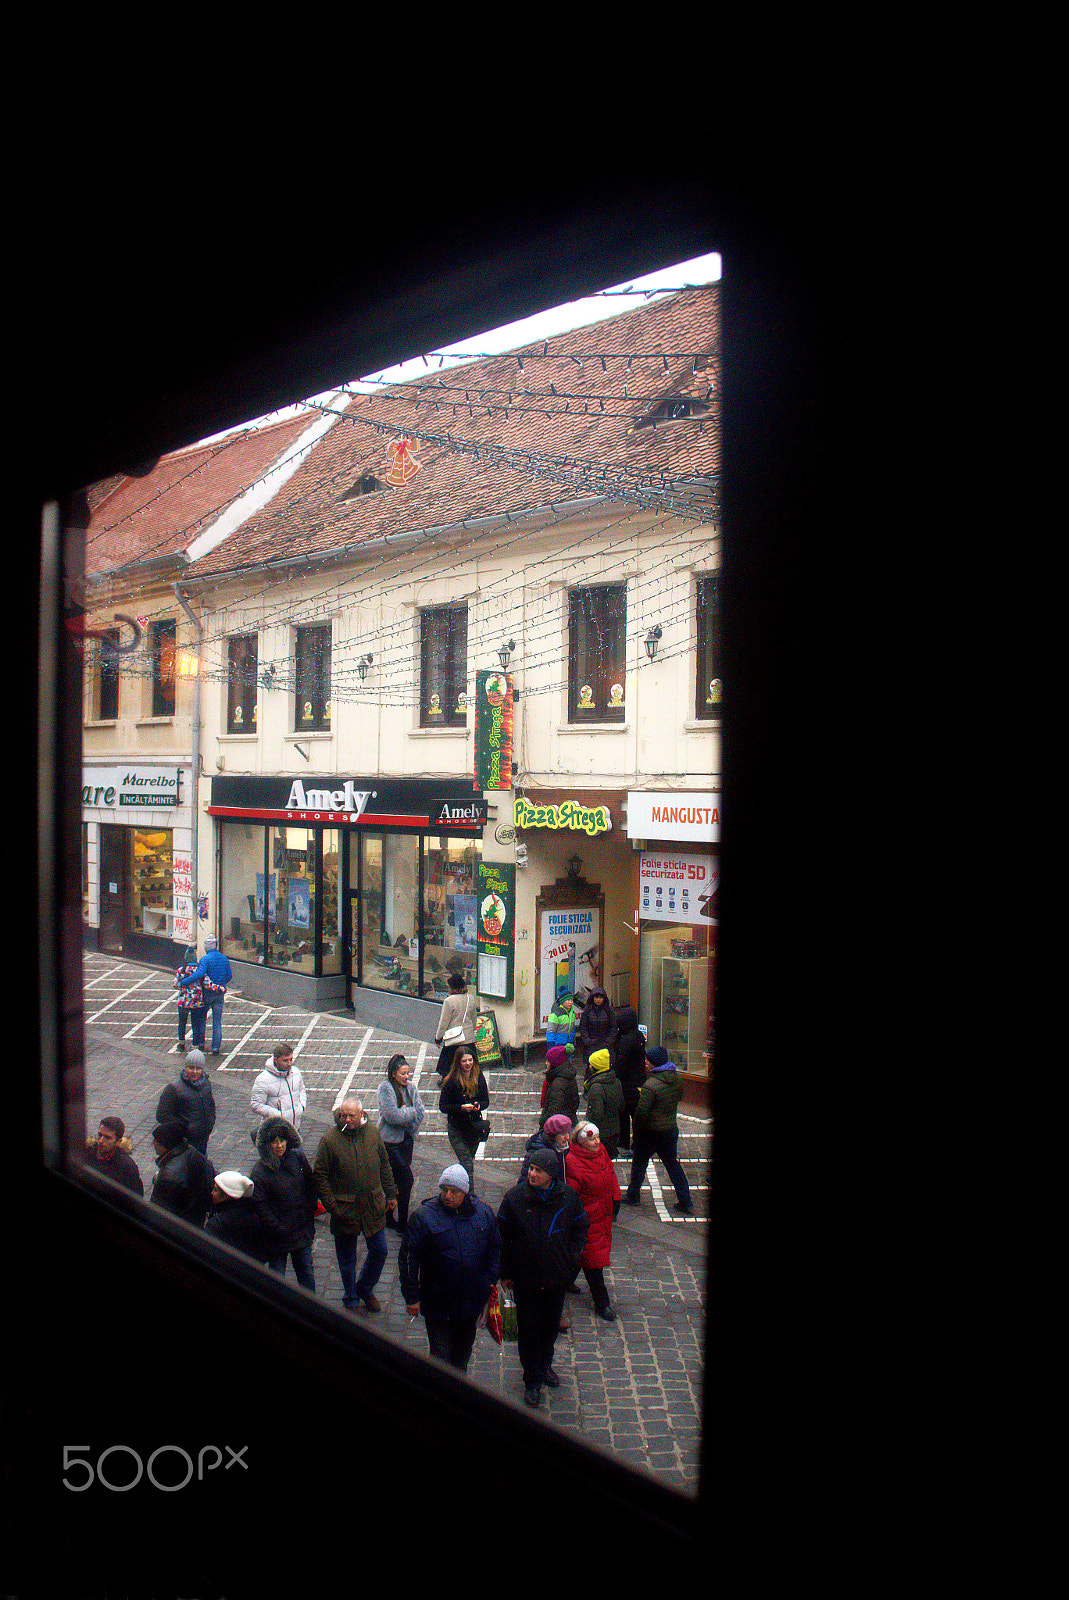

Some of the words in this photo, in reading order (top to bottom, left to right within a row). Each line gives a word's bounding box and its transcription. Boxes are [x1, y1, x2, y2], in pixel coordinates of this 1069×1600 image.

[489, 707, 503, 747] Strega
[488, 750, 500, 789] Pizza
[122, 773, 176, 787] Marelbo
[287, 812, 348, 821] SHOES
[439, 804, 483, 819] Amely
[514, 800, 557, 826] Pizza
[558, 803, 606, 833] Strega
[652, 806, 720, 825] MANGUSTA
[479, 864, 500, 878] Pizza
[641, 859, 661, 868] Folie
[663, 860, 687, 870] sticla
[641, 869, 684, 879] securizata
[687, 865, 706, 880] 5D
[486, 878, 508, 893] Strega
[548, 914, 568, 925] FOLIE
[548, 948, 558, 959] 20
[558, 944, 568, 955] LEI
